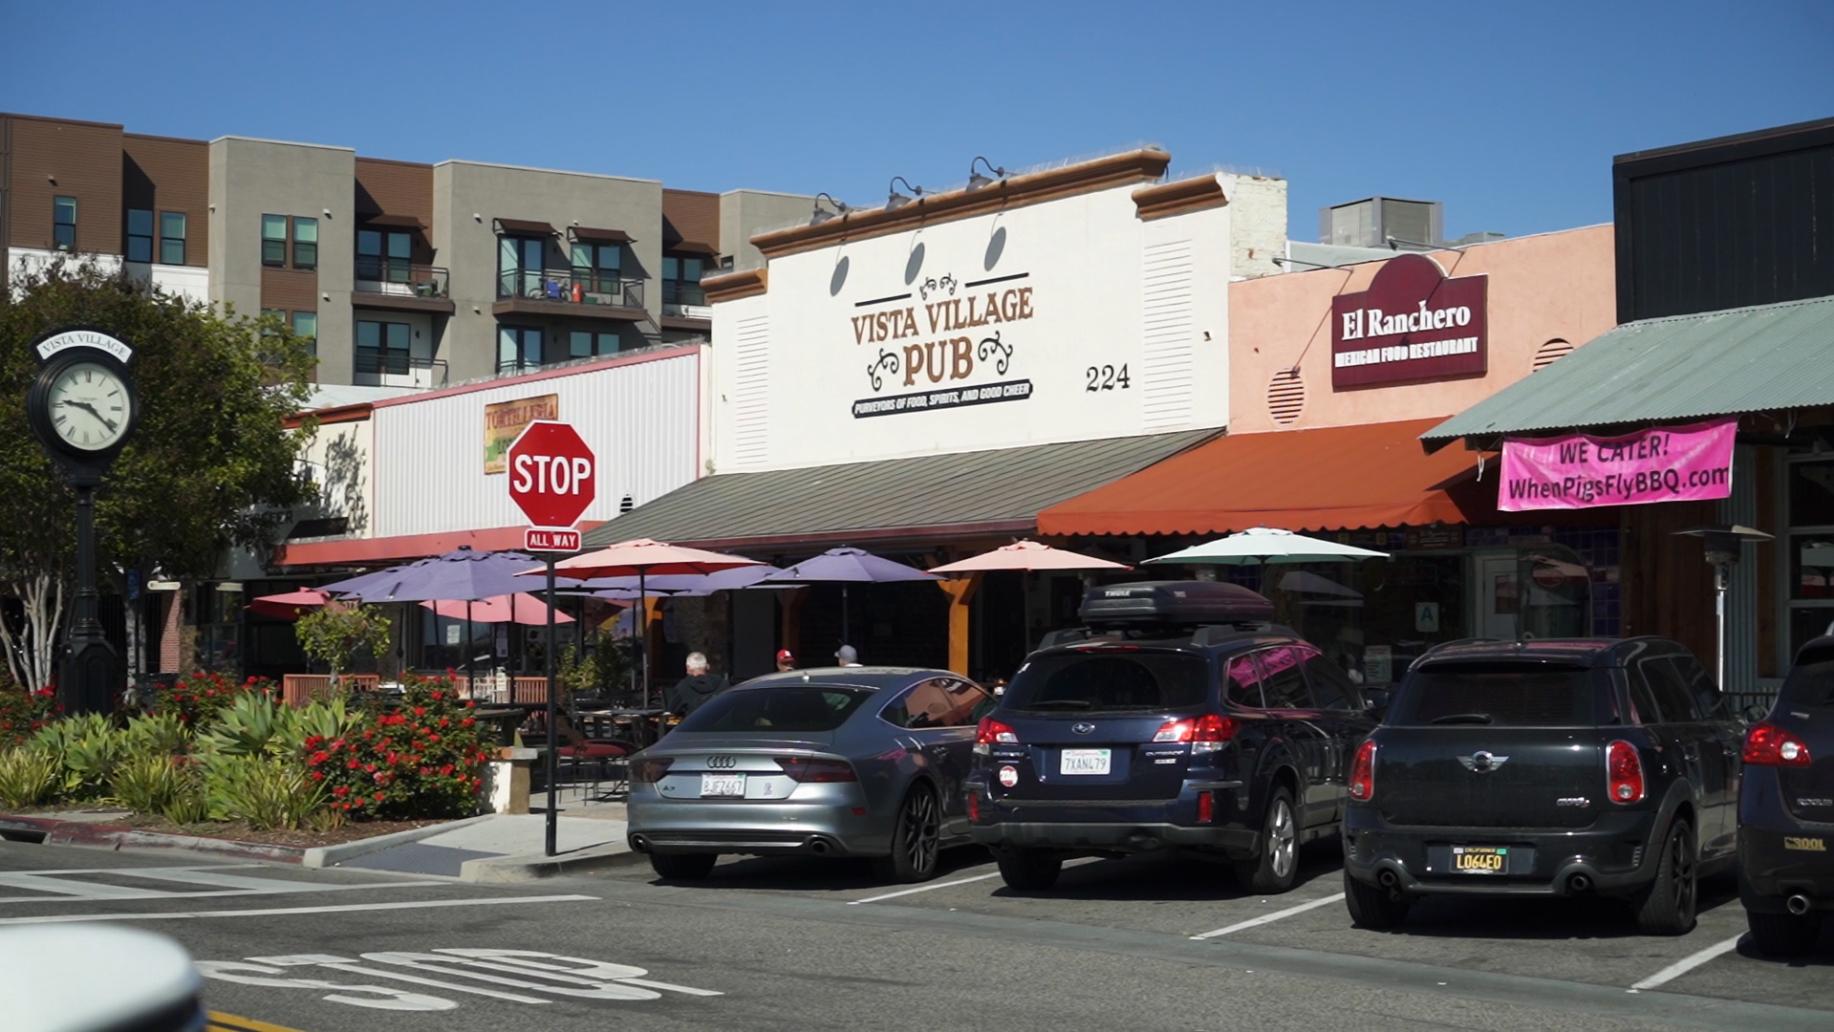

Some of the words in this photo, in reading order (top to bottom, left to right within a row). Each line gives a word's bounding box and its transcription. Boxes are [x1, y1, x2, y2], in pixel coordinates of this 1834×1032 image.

[850, 306, 919, 345] VISTA
[926, 287, 1033, 334] VILLAGE
[1342, 308, 1363, 340] El
[1367, 300, 1471, 337] Ranchero
[43, 335, 75, 353] VISTA
[77, 334, 127, 356] VILLAGE
[903, 336, 974, 386] PUB
[1334, 348, 1380, 368] MEXICAN
[1381, 345, 1409, 363] FOOD
[1409, 337, 1478, 360] RESTAURANT
[1086, 363, 1130, 393] 224
[854, 399, 896, 415] PURVEYORS
[896, 397, 907, 410] OF
[960, 389, 979, 401] AND
[980, 386, 1002, 399] GOOD
[1003, 382, 1030, 397] CHEER
[1560, 442, 1588, 464] WE
[1596, 433, 1671, 463] CATER!
[513, 454, 591, 495] STOP
[1509, 466, 1729, 502] WhenPigsFlyBBQ.com
[529, 533, 549, 547] ALL
[552, 534, 576, 547] WAY
[1420, 606, 1434, 622] A
[195, 948, 725, 1011] STOP
